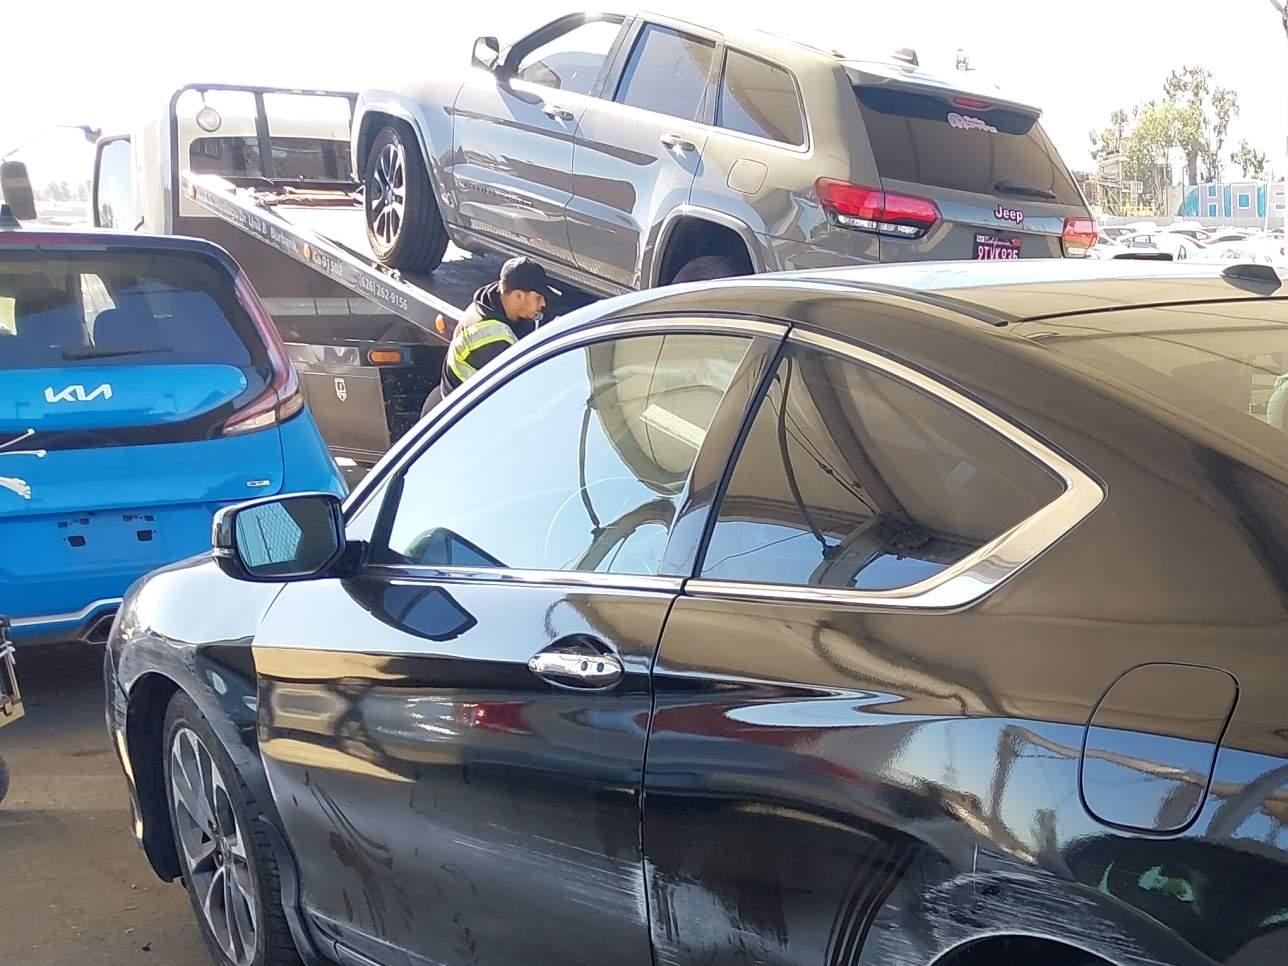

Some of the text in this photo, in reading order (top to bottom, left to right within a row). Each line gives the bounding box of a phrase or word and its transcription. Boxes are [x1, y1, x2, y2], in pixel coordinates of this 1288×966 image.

[995, 205, 1023, 223] Jeep
[377, 287, 408, 311] 262-9156
[44, 383, 113, 403] KIA
